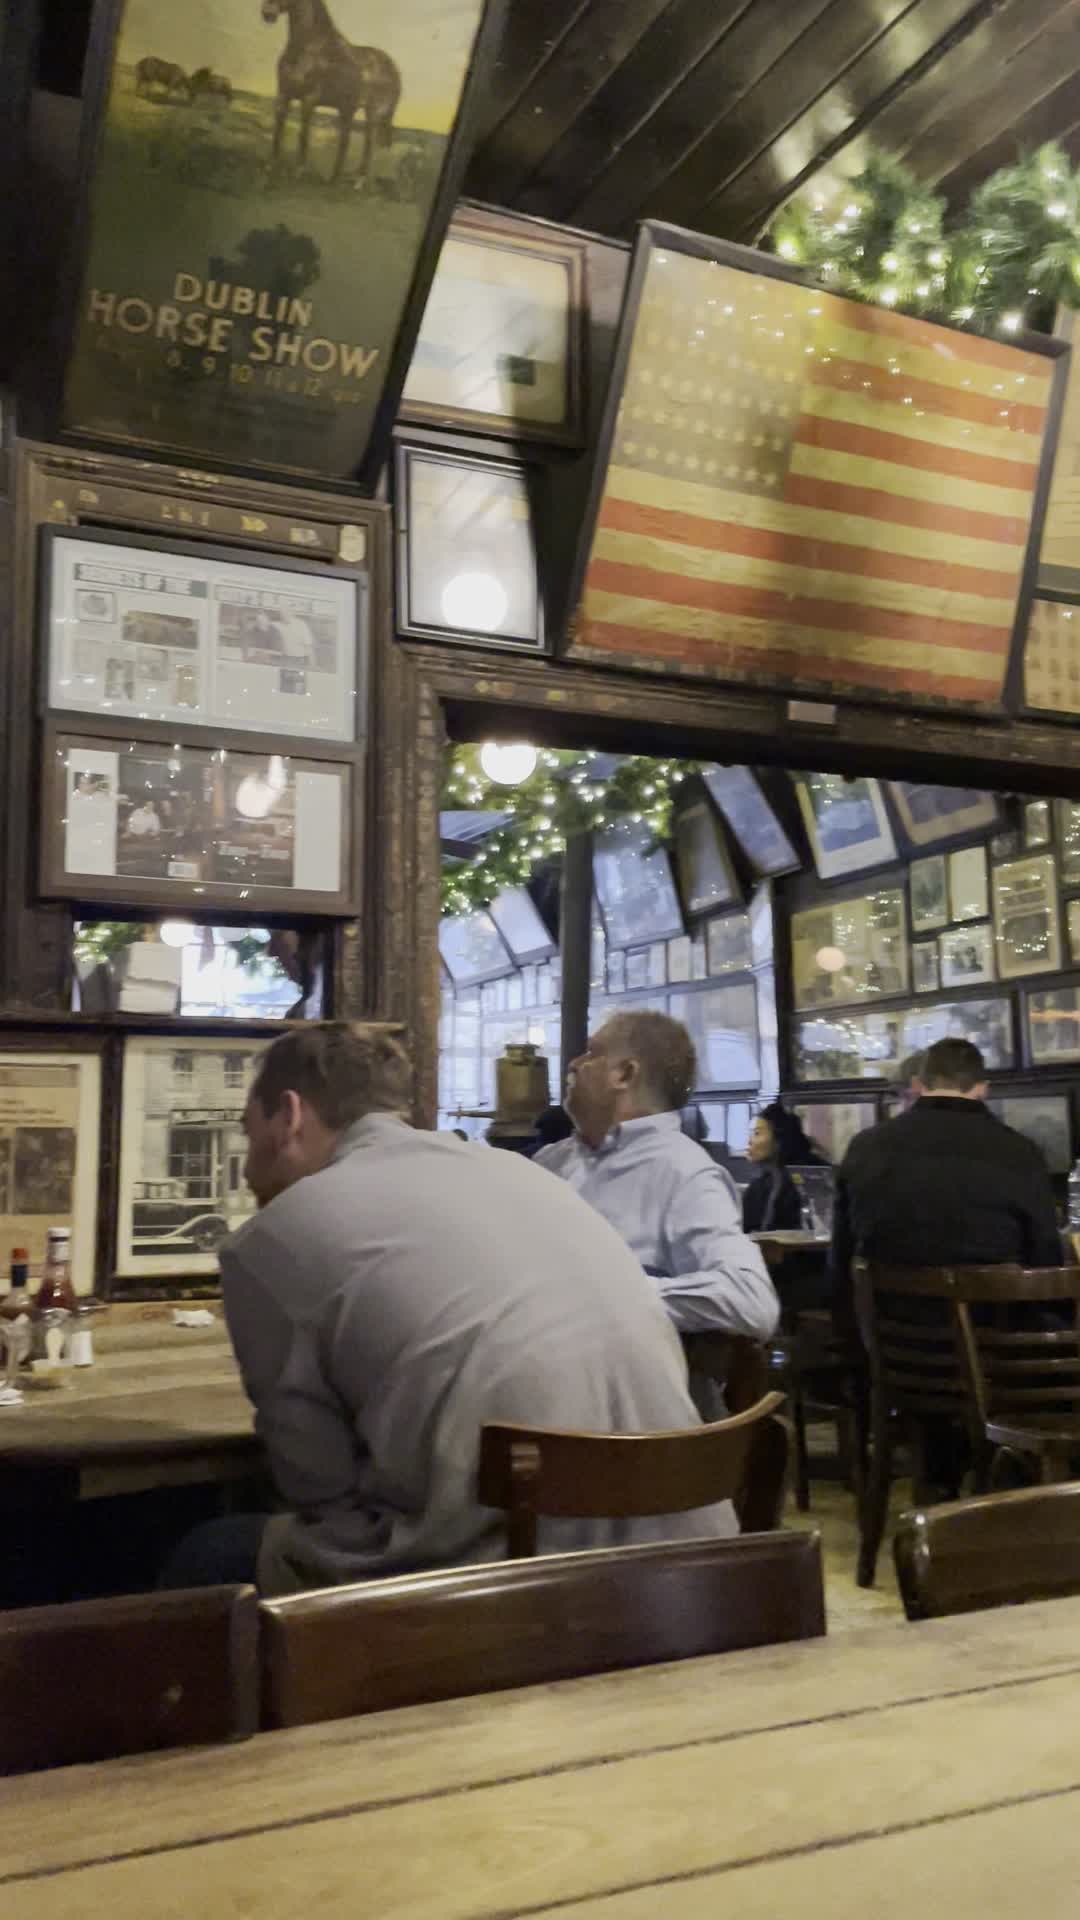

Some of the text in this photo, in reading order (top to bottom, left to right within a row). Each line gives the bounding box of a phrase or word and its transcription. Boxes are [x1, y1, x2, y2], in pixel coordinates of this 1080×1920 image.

[88, 288, 380, 379] HORSE SHOW
[174, 272, 313, 327] DUBLIN
